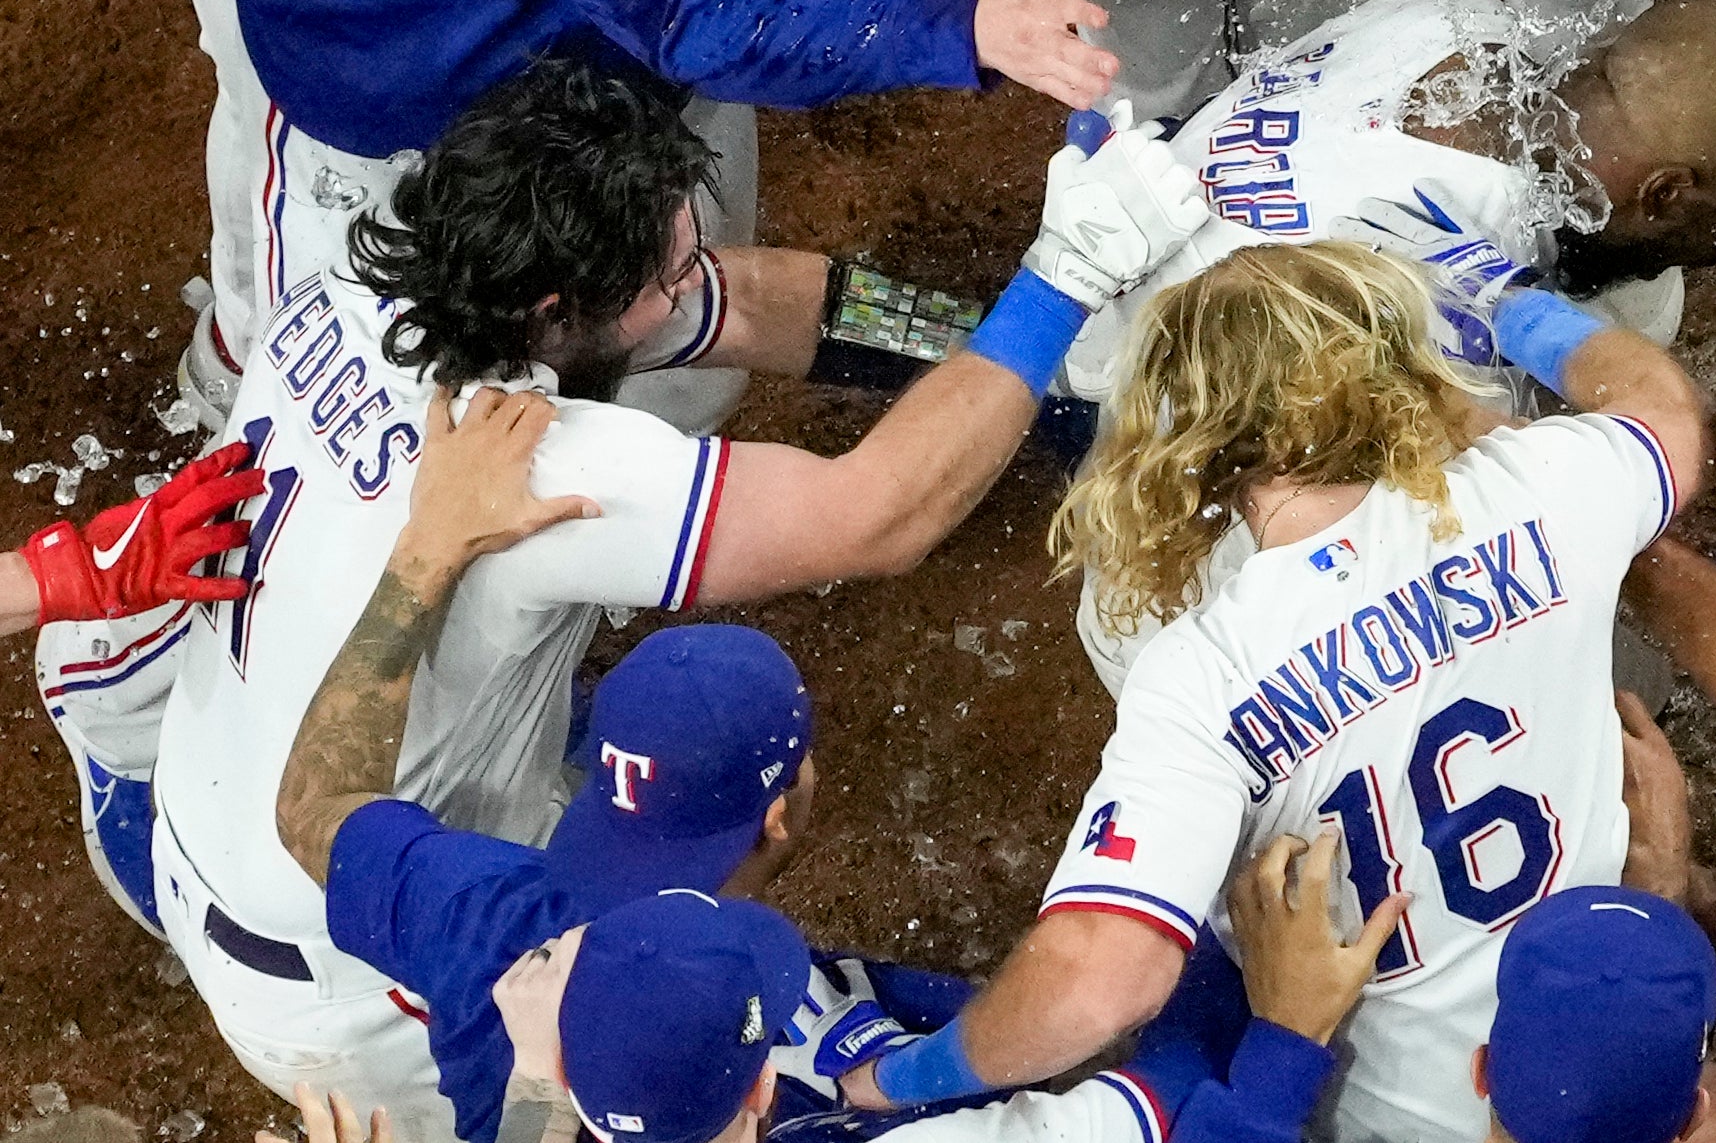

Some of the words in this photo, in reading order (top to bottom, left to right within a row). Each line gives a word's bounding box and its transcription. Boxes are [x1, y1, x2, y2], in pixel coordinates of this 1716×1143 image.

[601, 742, 656, 813] T
[1224, 519, 1568, 804] JANKOWSKI
[1318, 697, 1565, 983] 16
